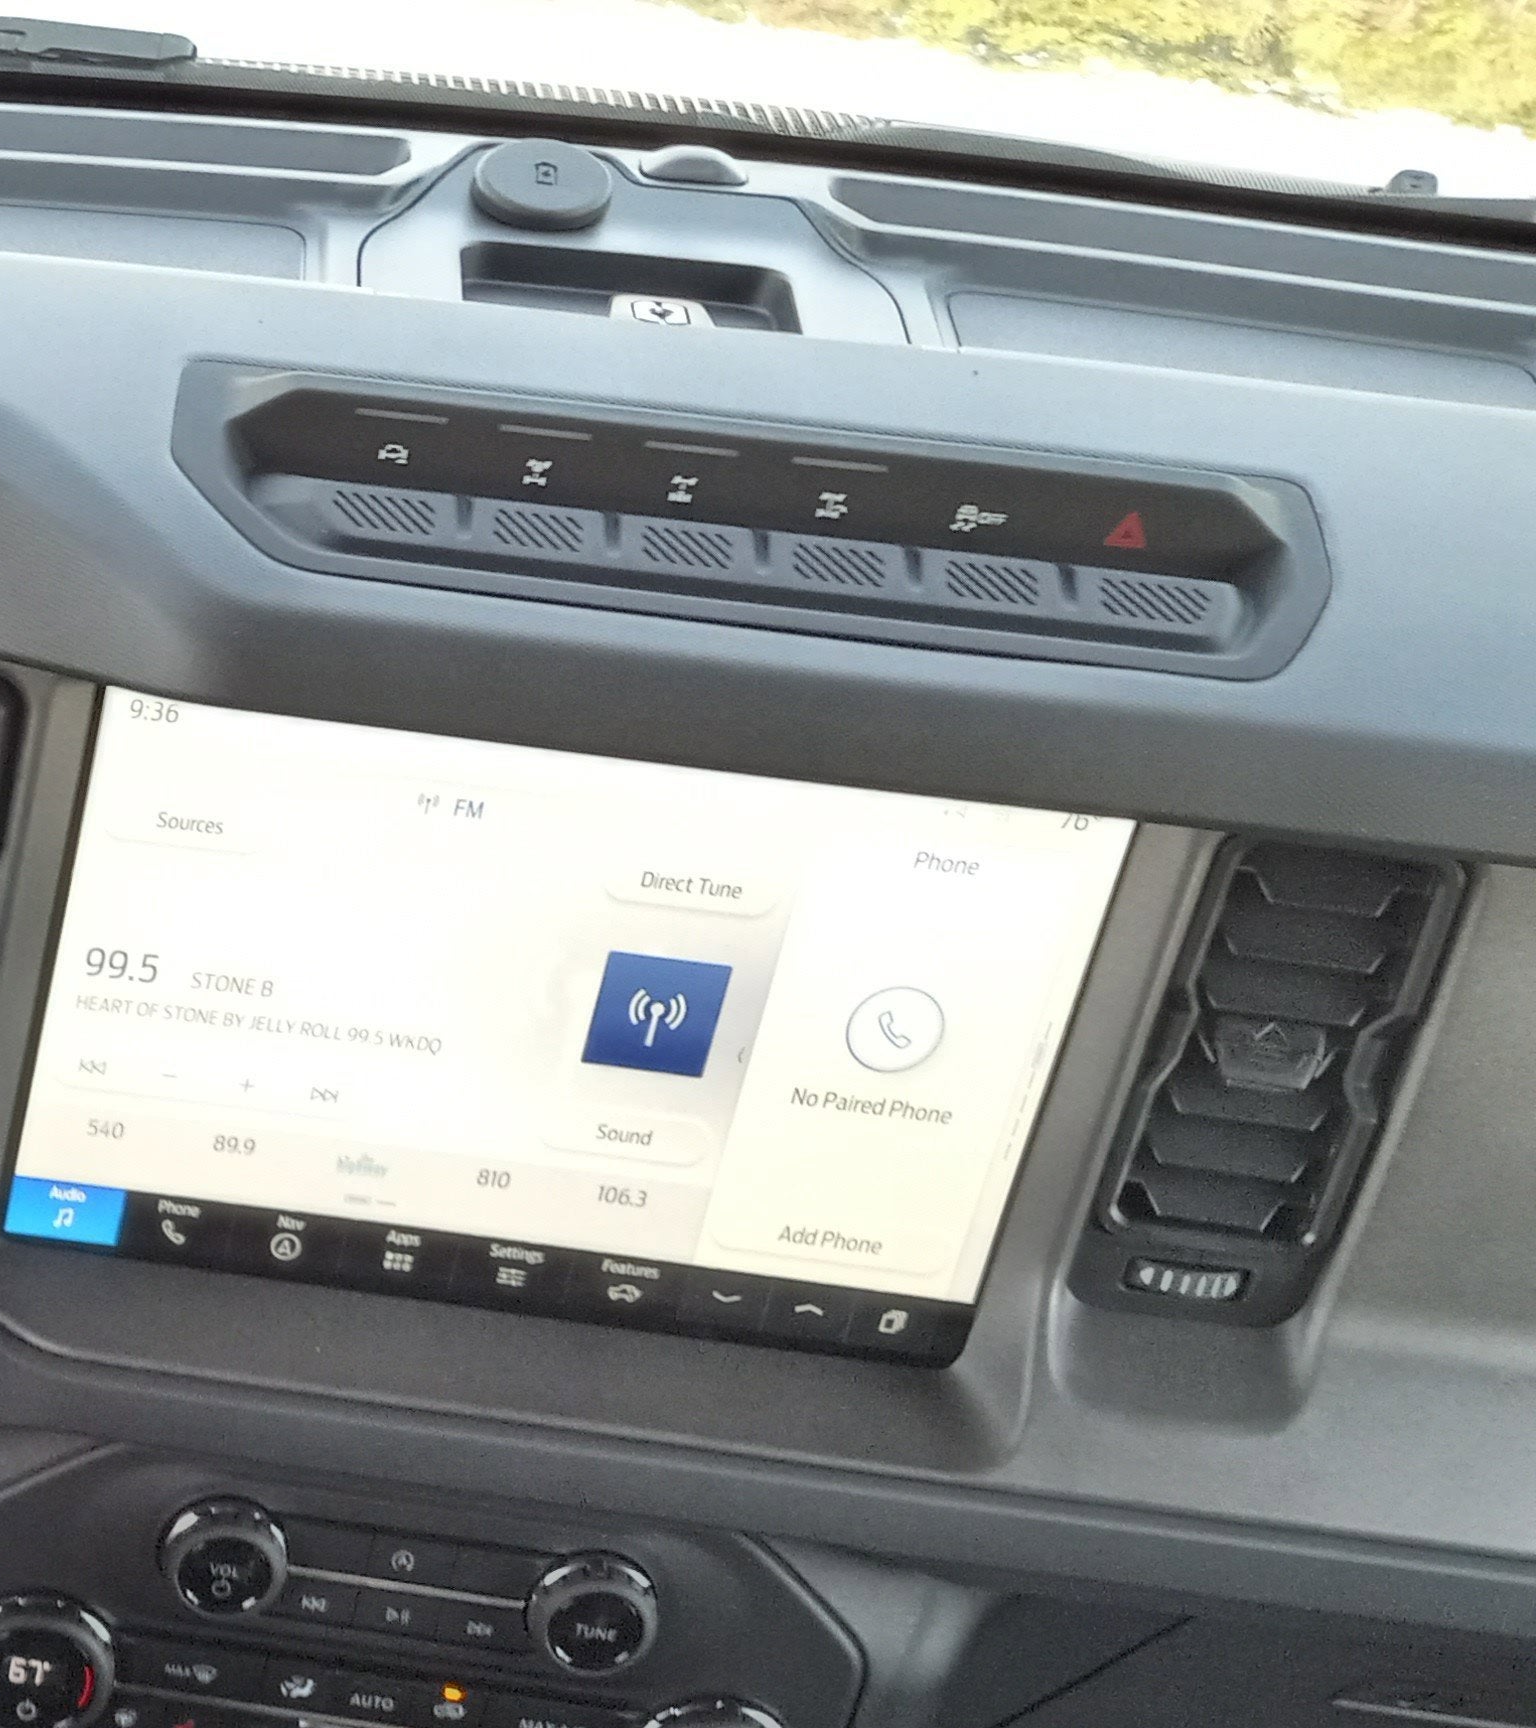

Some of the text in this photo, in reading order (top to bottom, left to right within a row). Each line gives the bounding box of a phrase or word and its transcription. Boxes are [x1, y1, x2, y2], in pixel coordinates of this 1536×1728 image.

[128, 698, 180, 724] 9:36
[453, 798, 485, 820] FM
[155, 811, 225, 836] Sources
[912, 850, 981, 877] Phone
[640, 869, 744, 901] Direct Tune
[85, 947, 275, 998] 99.5 STONE B
[75, 995, 134, 1015] HEART
[136, 1001, 159, 1018] OF
[163, 1004, 219, 1027] STONE
[222, 1011, 245, 1029] BY
[248, 1015, 297, 1035] JELLY
[299, 1020, 342, 1042] ROLL
[346, 1026, 385, 1046] 99.5
[790, 1086, 953, 1126] No Paired Phone
[86, 1117, 125, 1140] 540
[595, 1122, 653, 1147] Sound
[212, 1133, 257, 1157] 89.9
[476, 1168, 512, 1190] 810
[48, 1184, 88, 1204] Audio
[596, 1184, 649, 1208] 106.3
[157, 1199, 202, 1220] Phone
[277, 1214, 307, 1232] Nav
[385, 1229, 422, 1248] Apps
[777, 1224, 884, 1255] Add Phone
[489, 1242, 546, 1266] Settings
[600, 1257, 662, 1281] Features
[209, 1561, 239, 1580] VOL
[575, 1621, 619, 1643] TUNE
[349, 1692, 395, 1713] AUTO
